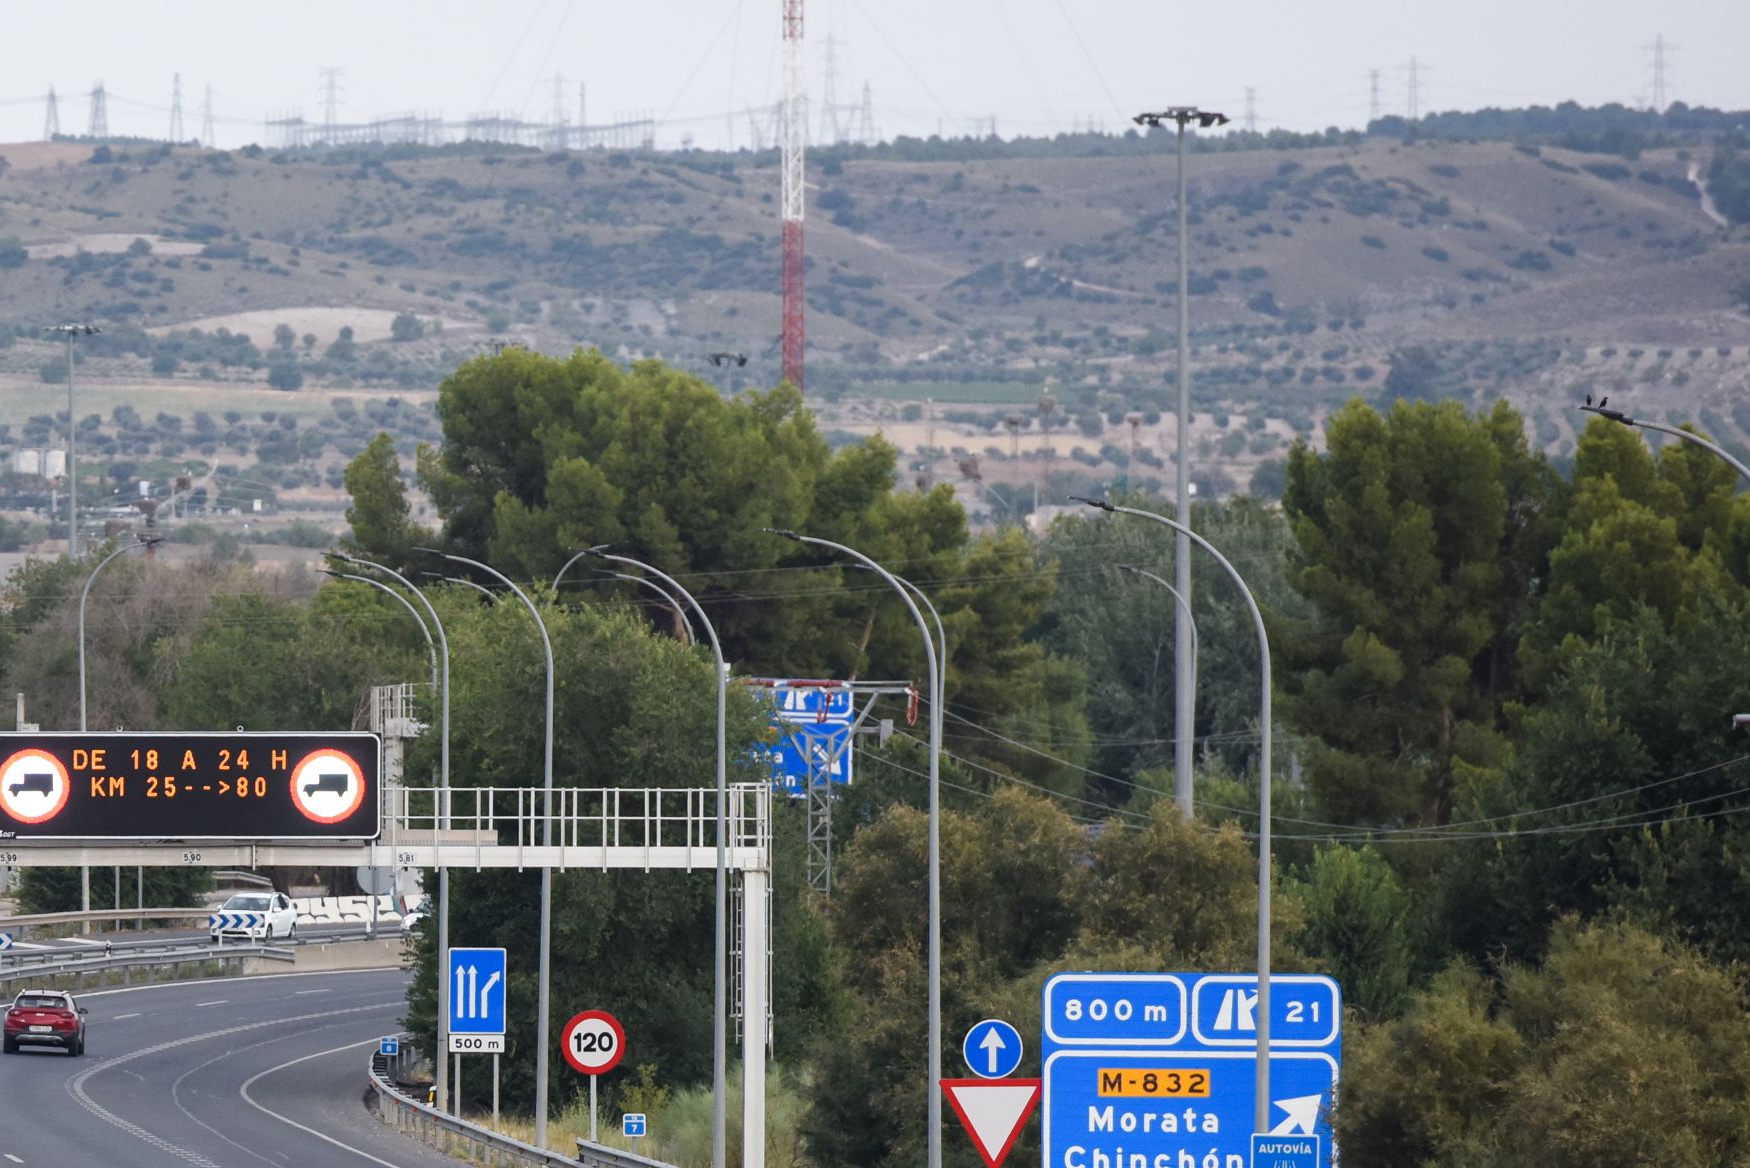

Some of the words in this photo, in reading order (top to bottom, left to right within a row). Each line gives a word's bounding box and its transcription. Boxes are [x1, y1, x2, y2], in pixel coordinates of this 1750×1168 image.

[73, 749, 106, 770] DE
[131, 749, 159, 770] 18
[181, 749, 197, 770] A
[218, 749, 249, 770] 24
[271, 749, 288, 770] H
[91, 776, 125, 797] KM
[1065, 999, 1134, 1021] 800
[1144, 1004, 1167, 1022] m
[1285, 1001, 1320, 1023] 21
[455, 1038, 482, 1049] 500
[488, 1040, 499, 1049] m
[573, 1031, 614, 1053] 120
[1102, 1072, 1206, 1094] M-832
[631, 1124, 638, 1133] 7
[1088, 1106, 1220, 1134] Morata
[1258, 1141, 1312, 1155] AUTOVÍA
